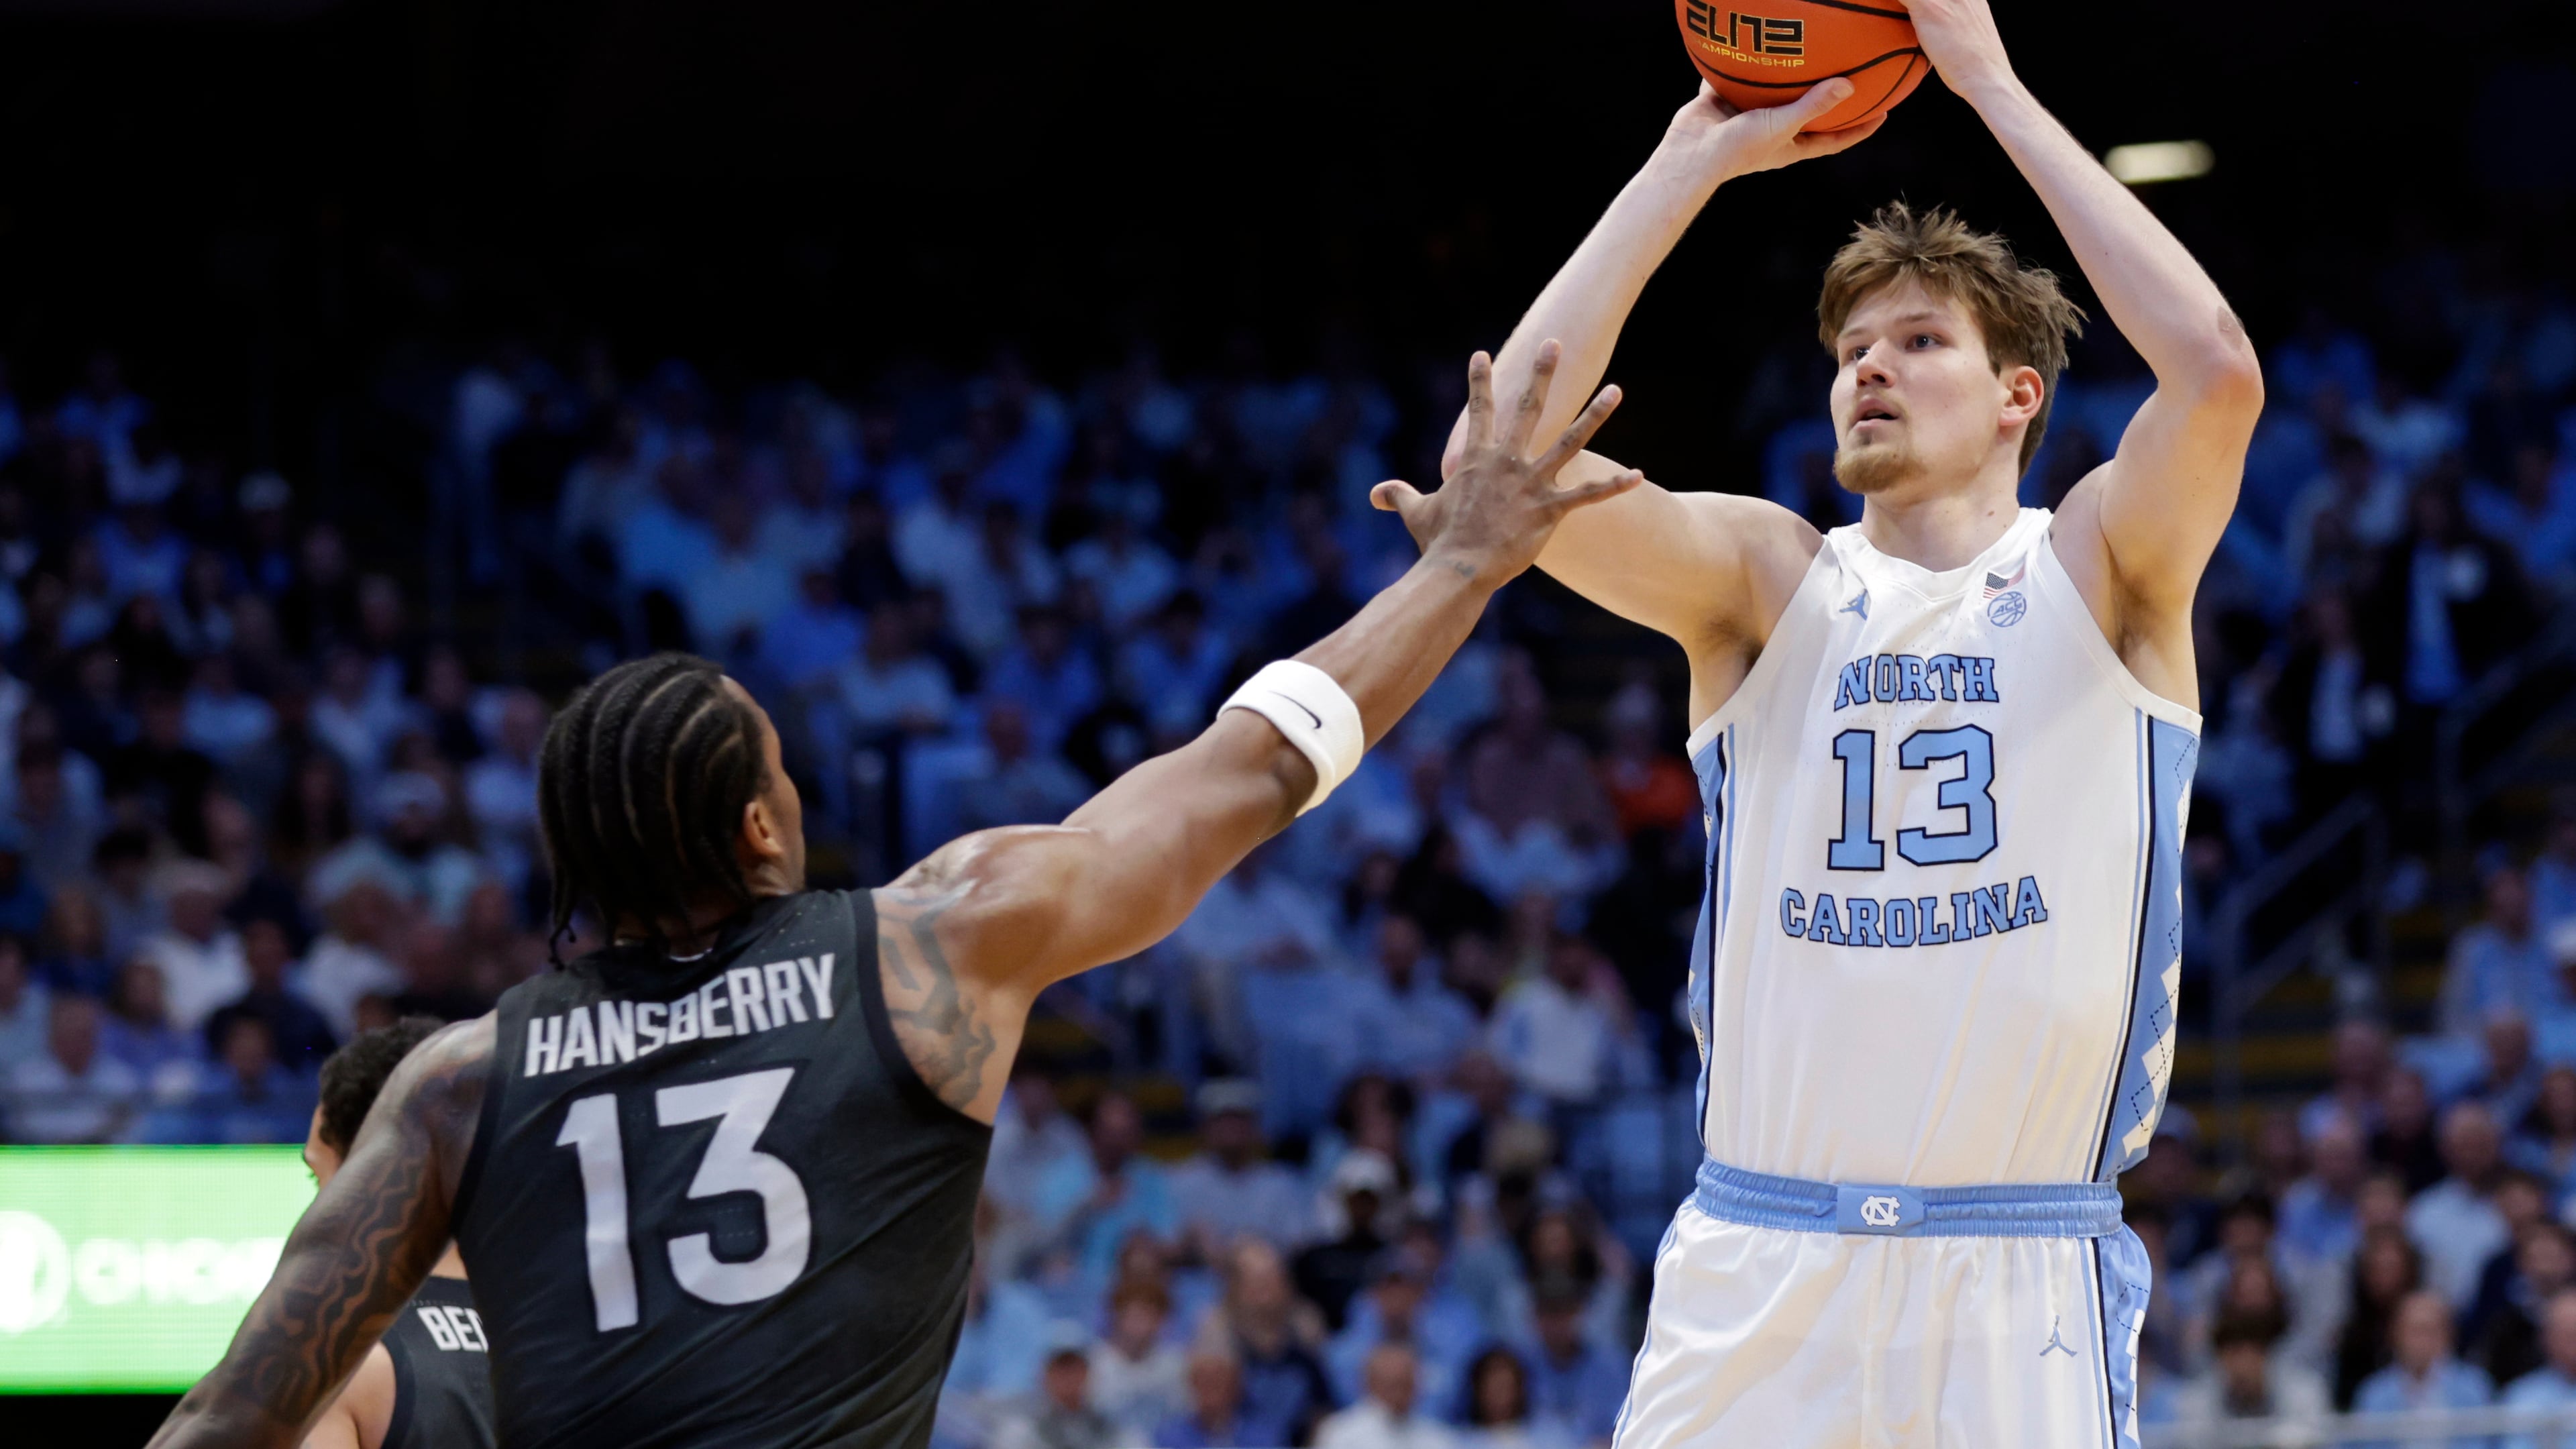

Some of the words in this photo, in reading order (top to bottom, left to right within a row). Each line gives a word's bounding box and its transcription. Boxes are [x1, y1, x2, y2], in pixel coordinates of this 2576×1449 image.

[1686, 0, 1805, 56] ELITE
[1991, 596, 2023, 618] ACC
[1834, 653, 1999, 711] NORTH
[1827, 724, 1998, 871] 13
[1780, 875, 2048, 947] CAROLINA
[524, 953, 837, 1077] HANSBERRY
[555, 1067, 812, 1333] 13
